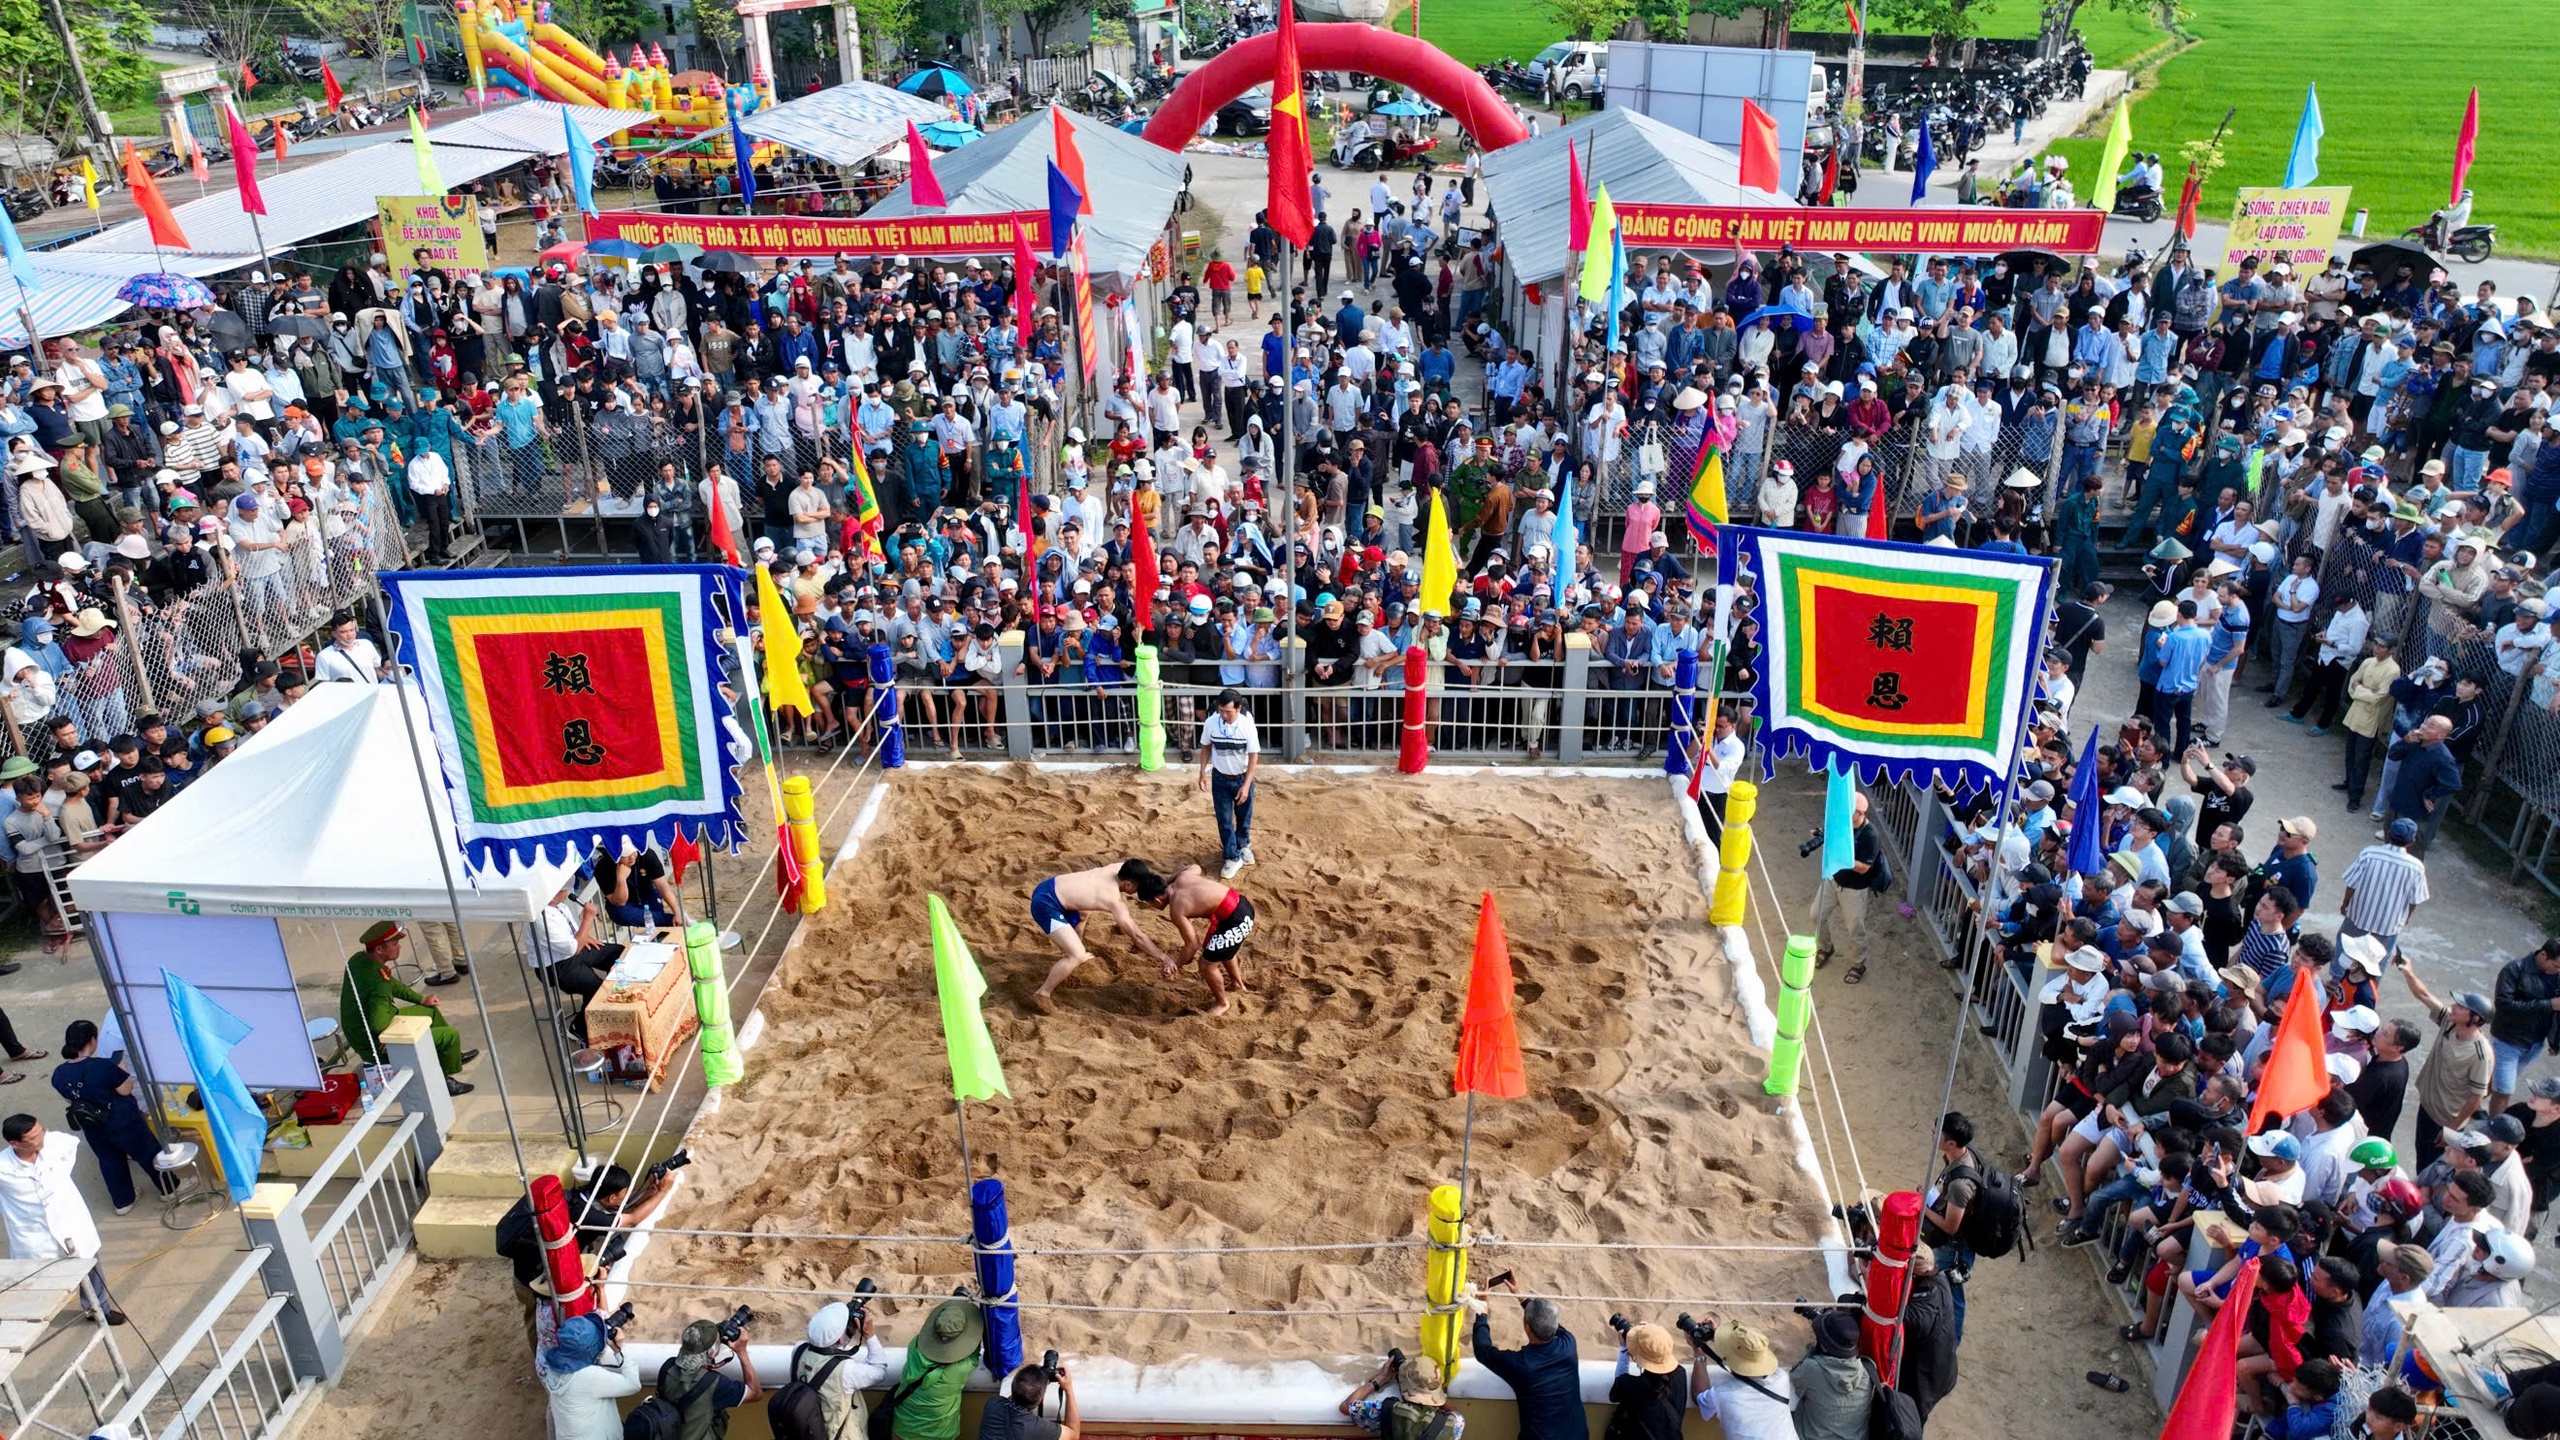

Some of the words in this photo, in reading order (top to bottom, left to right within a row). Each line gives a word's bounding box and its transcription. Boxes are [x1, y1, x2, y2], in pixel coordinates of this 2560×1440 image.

[2248, 197, 2275, 216] SỐNG,
[2278, 196, 2308, 215] CHIẾN
[618, 221, 660, 244] NƯỚC
[706, 223, 739, 246] HÒA
[739, 223, 761, 247] XÃ
[763, 224, 789, 250] HỘI
[792, 221, 823, 247] CHỦ
[825, 224, 873, 247] NGHĨA
[874, 223, 906, 249] VIỆT
[910, 226, 946, 246] NAM
[949, 221, 996, 245] MUÔN
[997, 219, 1039, 244] NM!
[1622, 210, 1669, 236] ĐẢNG
[1673, 213, 1722, 242] CỘNG
[1768, 216, 1804, 243] VIỆT
[1808, 221, 1850, 241] NAM
[1854, 221, 1913, 243] QUANG
[1917, 222, 1960, 242] VINH
[1962, 219, 2016, 243] MUÔN
[2020, 220, 2070, 244] NĂM!
[2259, 225, 2278, 239] LAO
[2370, 1156, 2389, 1164] Grab
